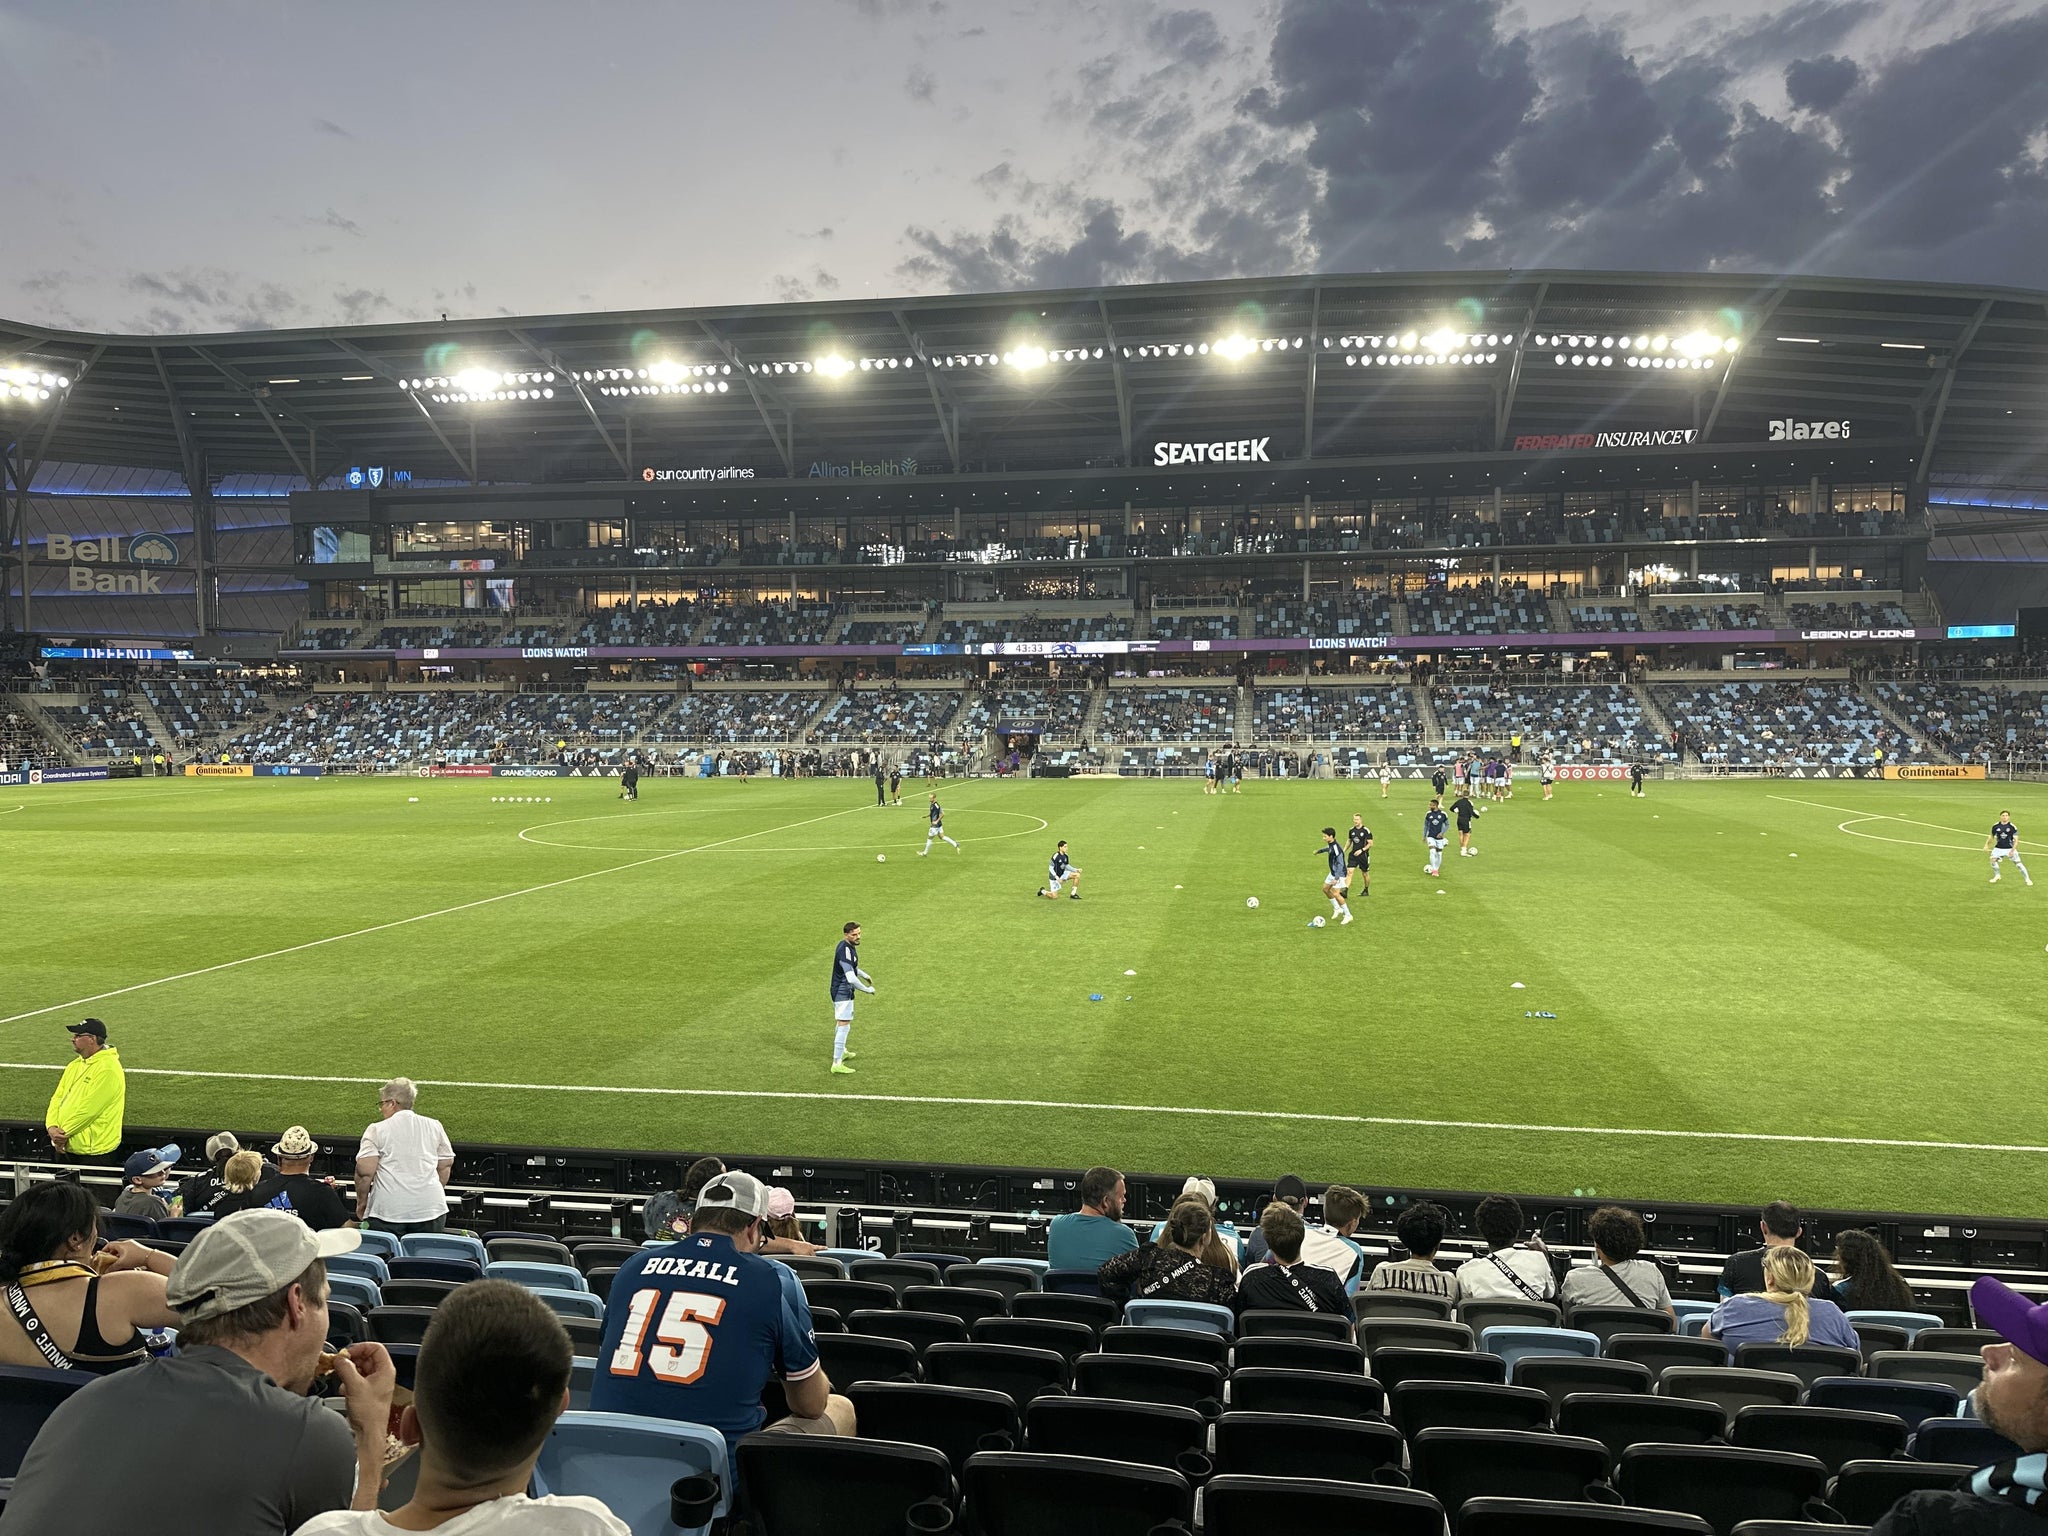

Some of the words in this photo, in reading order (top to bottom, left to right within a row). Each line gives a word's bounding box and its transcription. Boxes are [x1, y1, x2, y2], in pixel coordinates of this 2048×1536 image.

[1769, 418, 1841, 440] Blaze
[1514, 434, 1595, 450] FEDERATED
[1595, 429, 1684, 447] INSURANCE
[1153, 436, 1270, 467] SEATGEEK
[394, 471, 412, 482] MN
[656, 470, 675, 480] sun
[675, 466, 717, 481] country
[717, 466, 755, 479] airlines
[808, 461, 849, 479] Allina
[851, 459, 899, 476] Health
[47, 533, 120, 562] Bell
[69, 566, 162, 594] Bank
[1309, 638, 1346, 649] LOONS
[1348, 637, 1387, 648] WATCH
[1801, 631, 1849, 640] LEGION
[1849, 630, 1868, 639] OF
[1869, 629, 1916, 639] LOONS
[522, 648, 553, 658] LOONS
[554, 647, 588, 657] WATCH
[1015, 644, 1043, 653] 43:33
[195, 766, 237, 776] Continental
[290, 767, 301, 775] MN
[532, 769, 557, 777] CASINO
[1897, 766, 1960, 779] Continental
[640, 1257, 740, 1286] BOXALL
[1171, 1260, 1195, 1279] MNUFC
[1493, 1258, 1514, 1278] MNUFC
[1381, 1268, 1448, 1298] NIRVANA
[1298, 1288, 1319, 1312] MNUFC
[610, 1288, 727, 1385] 15
[36, 1332, 73, 1370] MNUFC
